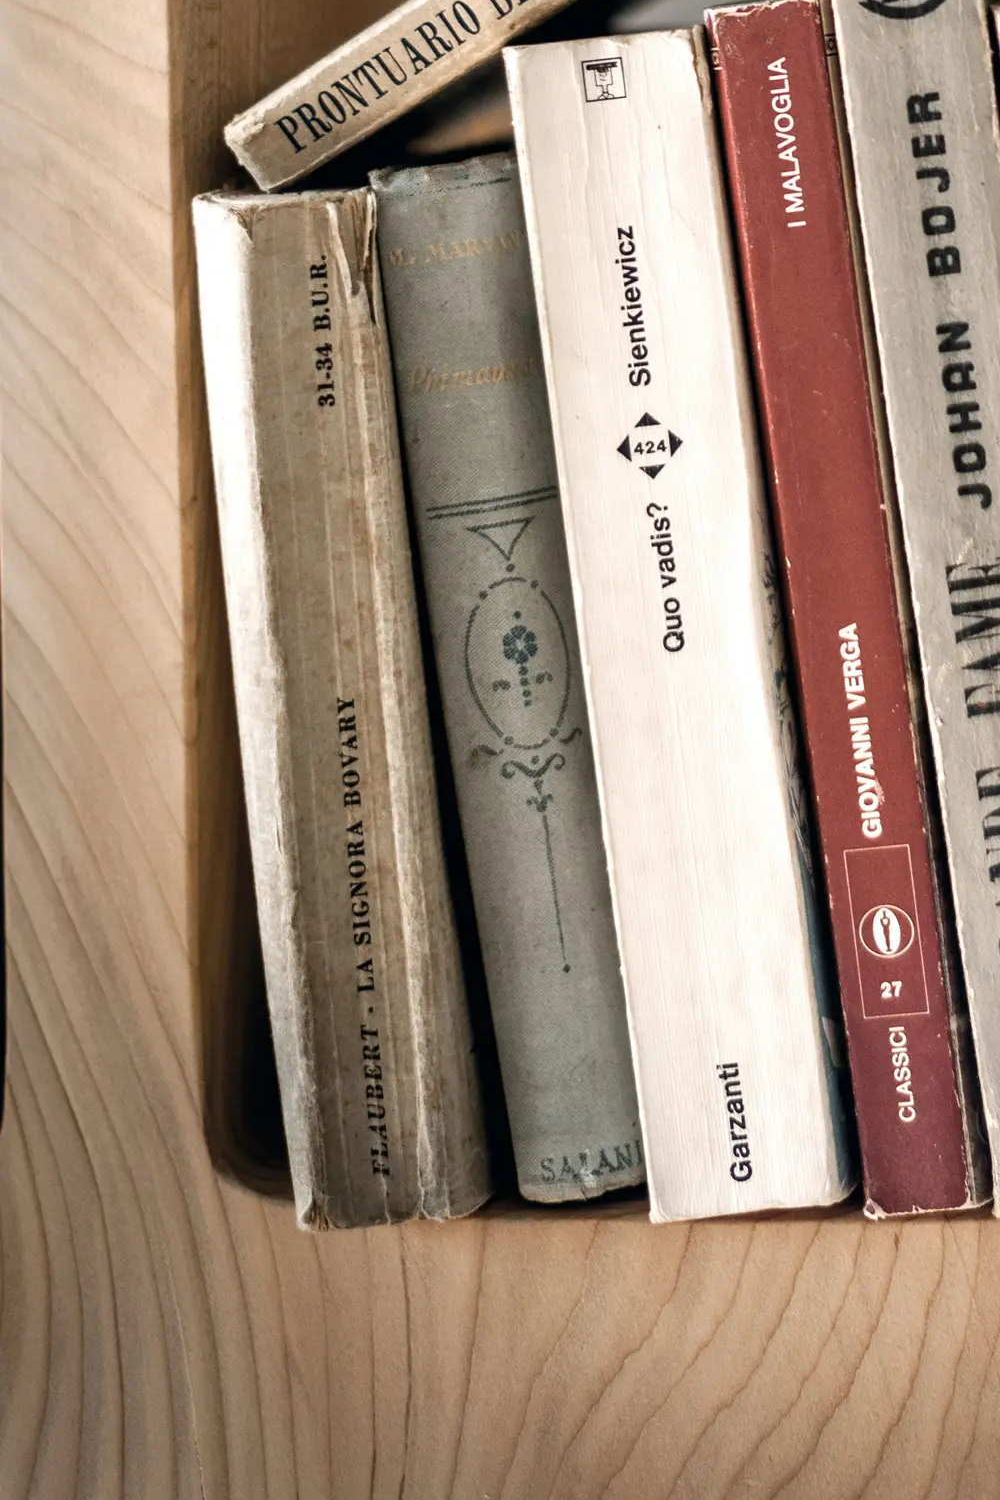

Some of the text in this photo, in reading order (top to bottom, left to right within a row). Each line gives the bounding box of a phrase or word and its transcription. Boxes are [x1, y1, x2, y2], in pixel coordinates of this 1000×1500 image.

[274, 1, 481, 153] PRONTUARIO
[767, 57, 805, 213] MALAVOGLIA
[310, 255, 335, 407] 31-34 B.U.R.
[615, 225, 651, 387] Sienkiewicz
[907, 91, 993, 510] JOHAN BOJER
[633, 439, 667, 455] 424
[646, 501, 685, 653] Quo vadis?
[337, 697, 361, 807] BOVARY
[838, 622, 883, 839] GIOVANNI VERGA
[346, 820, 372, 946] SIGNORA
[357, 958, 375, 992] LA
[880, 980, 903, 998] 27
[360, 1025, 390, 1176] FLAUBERT
[716, 1062, 753, 1182] Garzanti
[889, 1026, 917, 1122] CLASSICI
